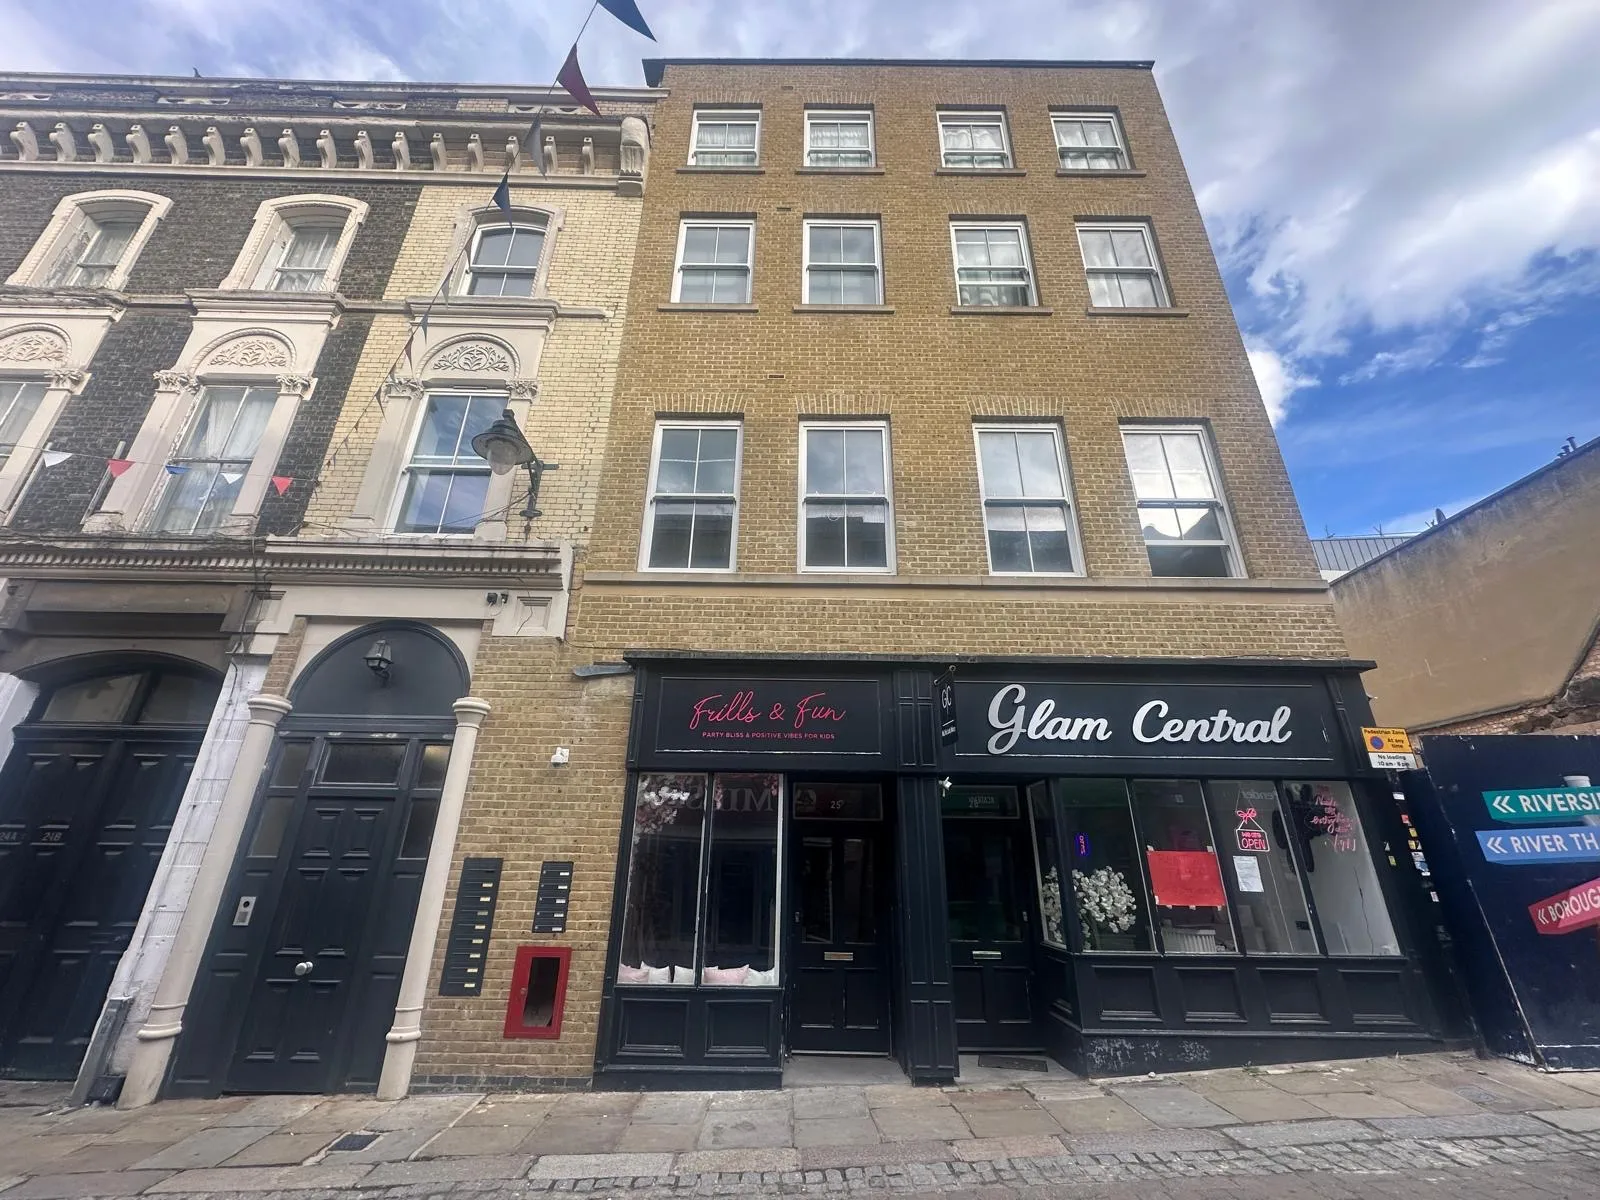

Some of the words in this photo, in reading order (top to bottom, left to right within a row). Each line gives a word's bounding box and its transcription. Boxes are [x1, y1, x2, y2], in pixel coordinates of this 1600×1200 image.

[689, 690, 762, 730] Frills
[769, 702, 786, 721] &
[794, 692, 847, 729] Fun
[987, 683, 1113, 755] Glam
[1131, 699, 1293, 743] Central
[1241, 837, 1266, 849] OPEN
[1509, 834, 1568, 853] RIVER
[1568, 832, 1600, 851] TH
